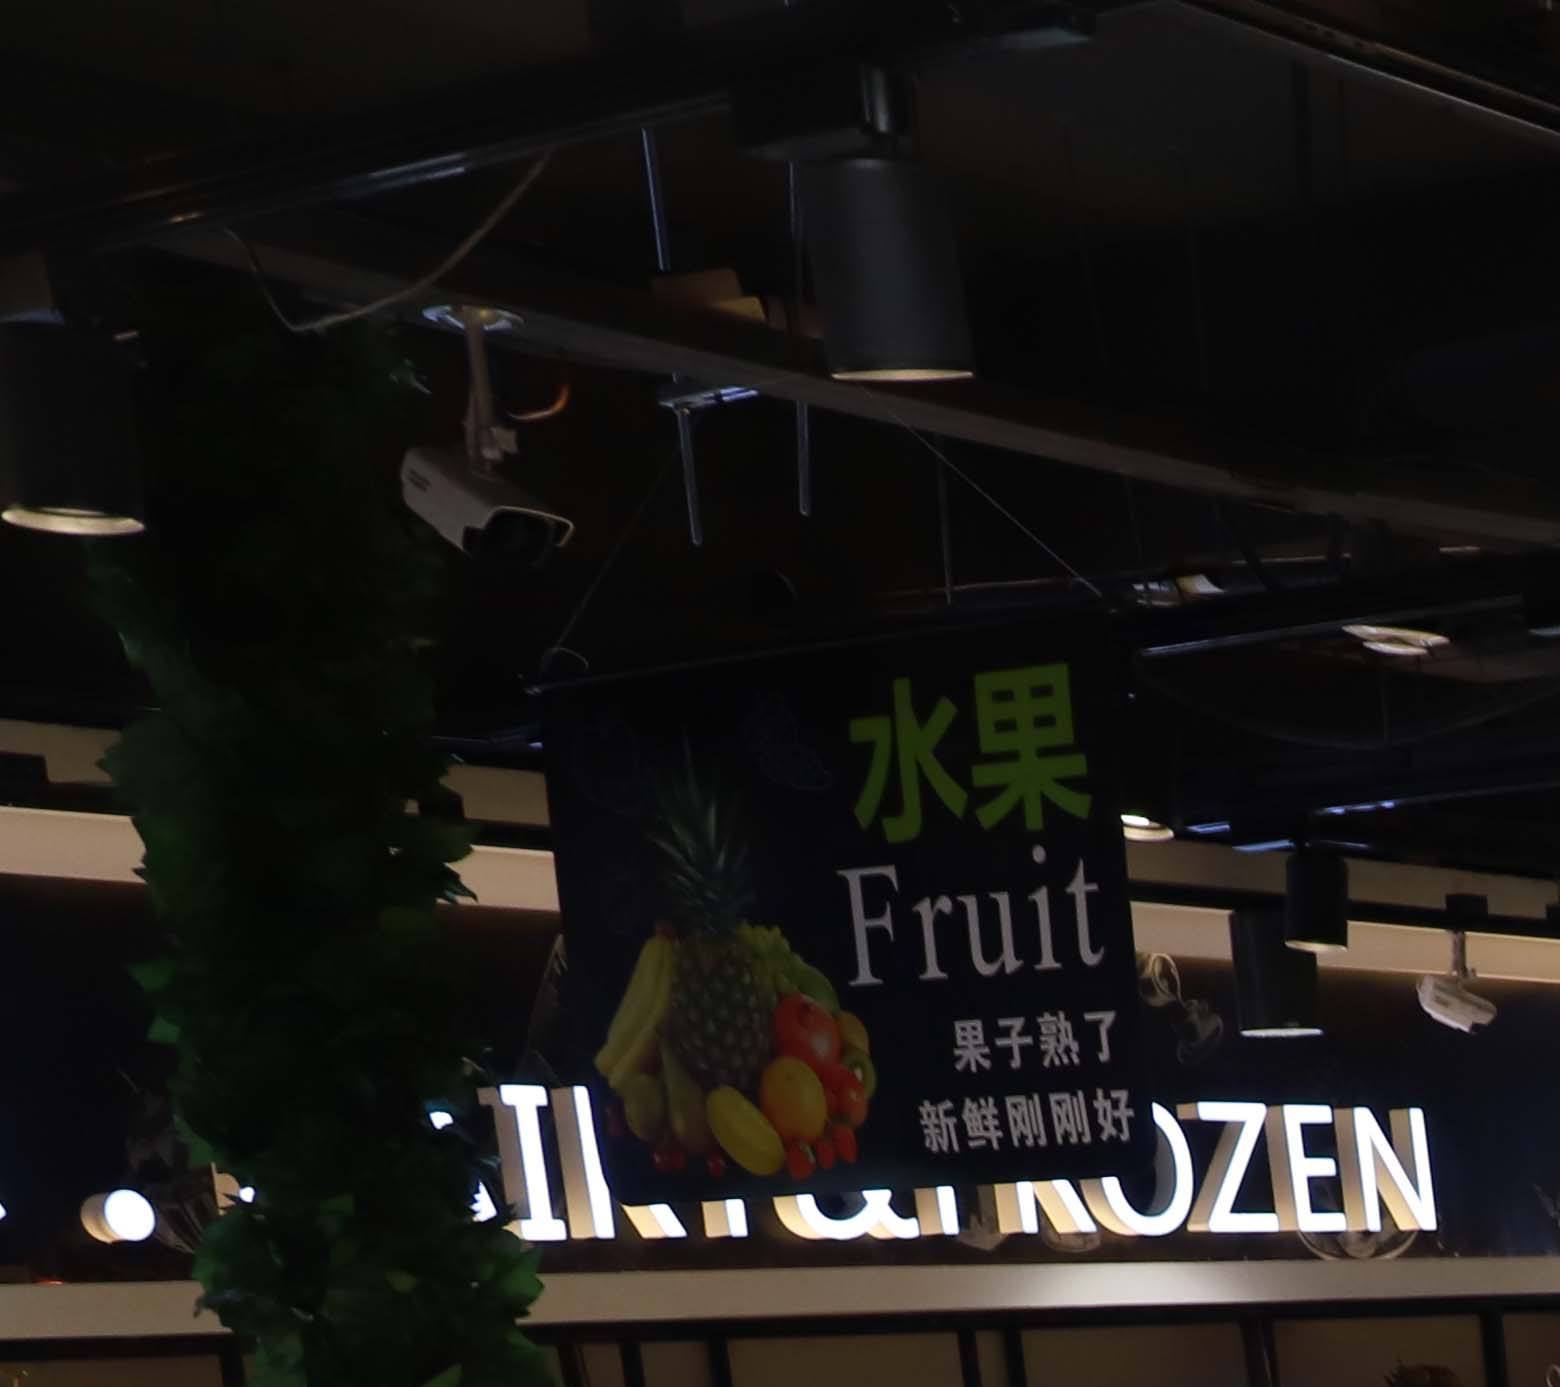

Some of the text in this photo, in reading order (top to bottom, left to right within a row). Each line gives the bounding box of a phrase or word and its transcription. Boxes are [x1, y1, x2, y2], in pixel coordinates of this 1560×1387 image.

[849, 662, 1093, 844] 水果
[837, 845, 1105, 988] Fruit
[953, 1011, 1118, 1073] 果子熟了
[919, 1089, 1136, 1156] 新鲜刚刚好
